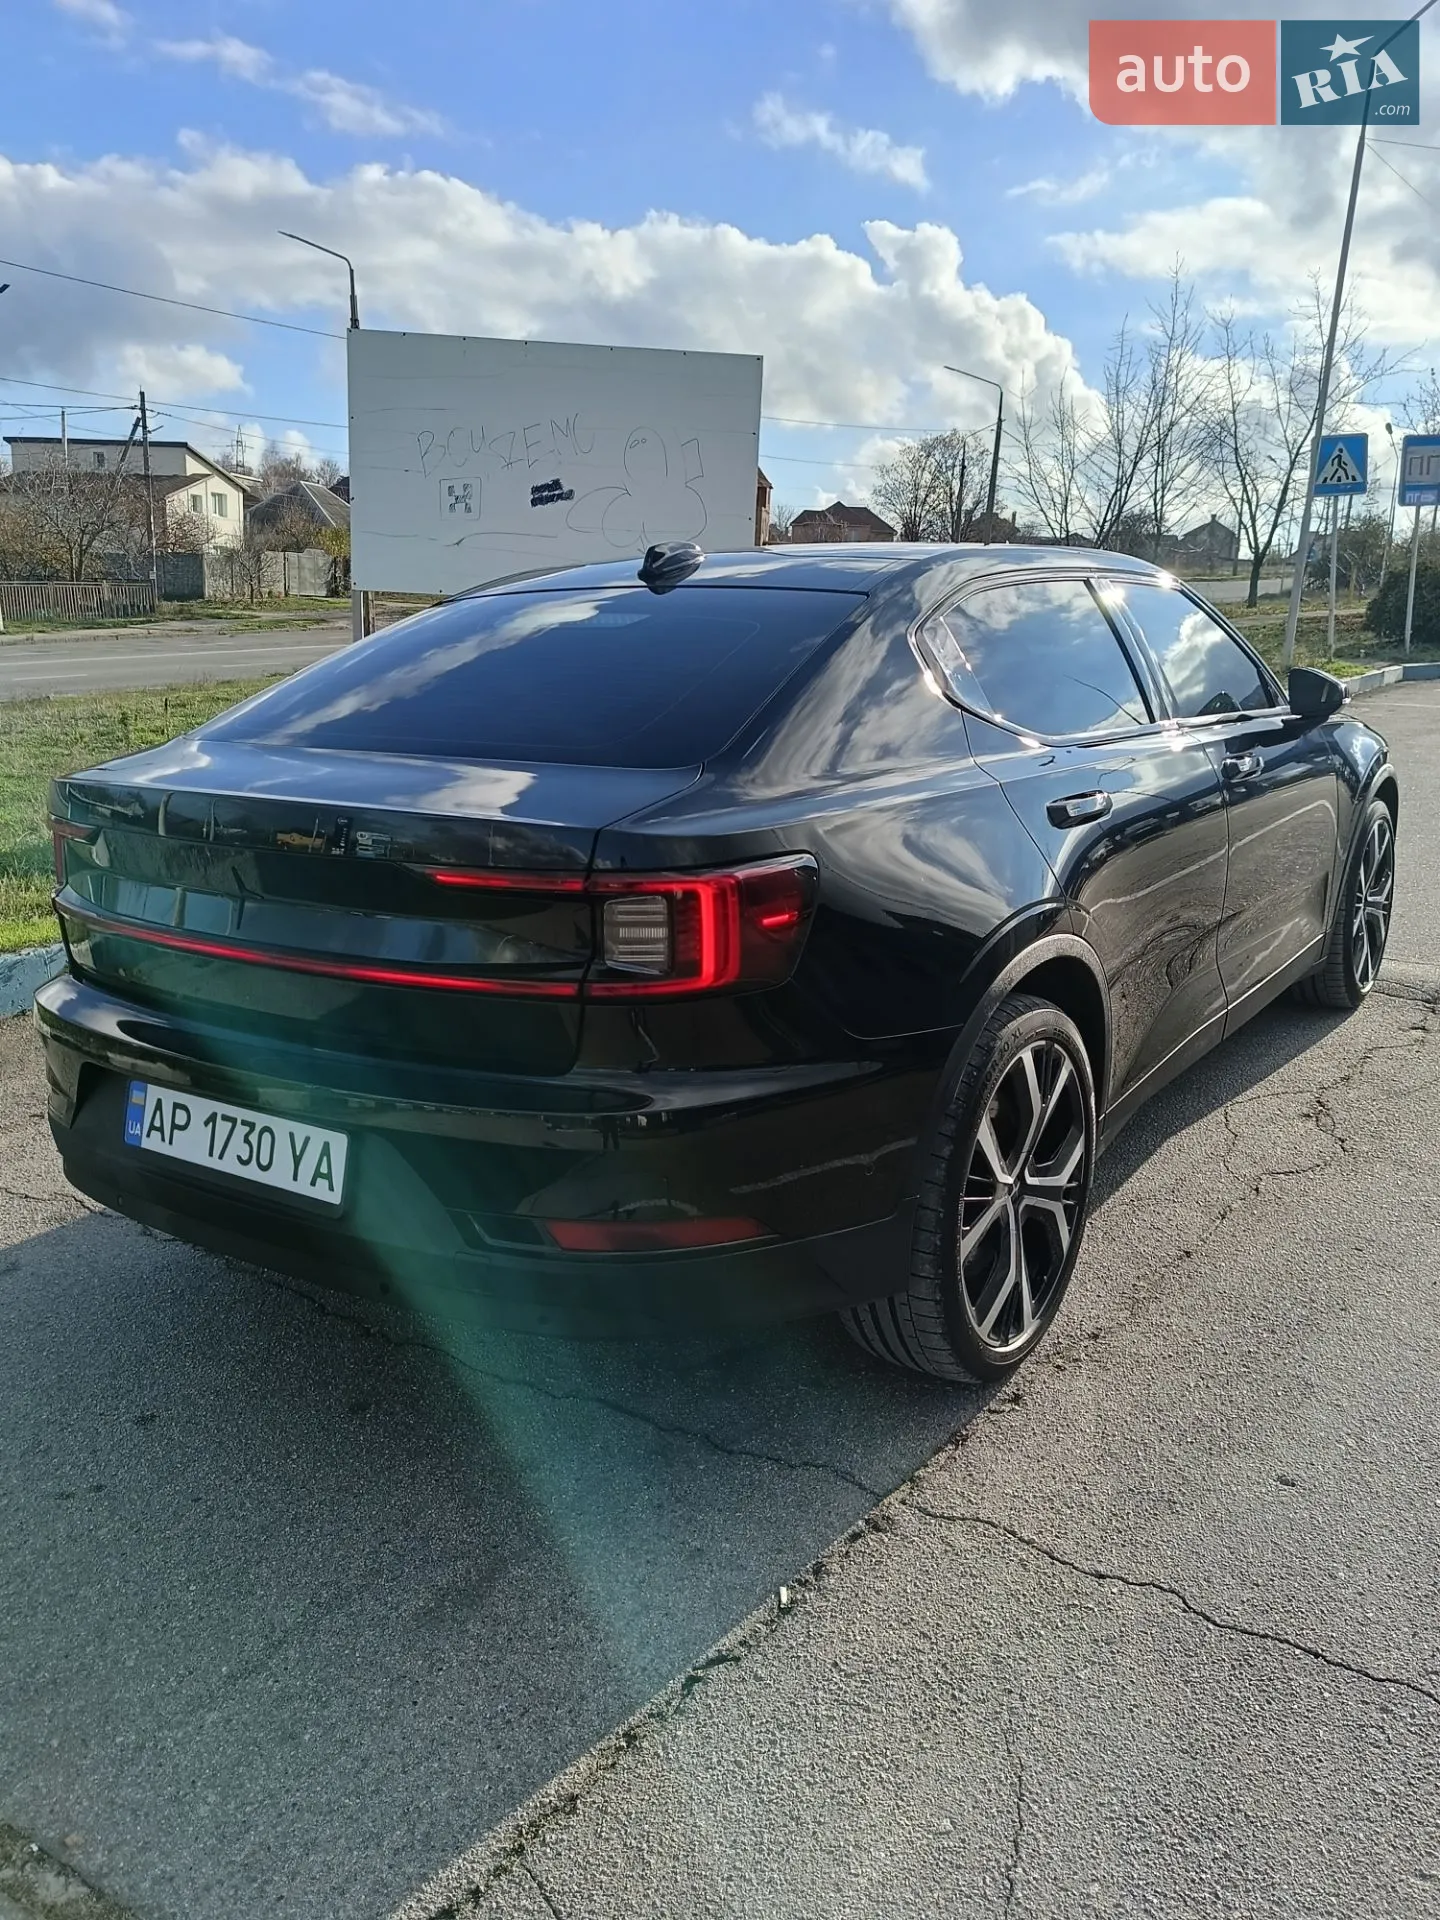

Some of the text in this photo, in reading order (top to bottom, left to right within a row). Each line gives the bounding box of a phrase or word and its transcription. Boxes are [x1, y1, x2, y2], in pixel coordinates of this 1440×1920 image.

[128, 1121, 141, 1136] UA
[146, 1097, 335, 1192] AP 1730 YA
